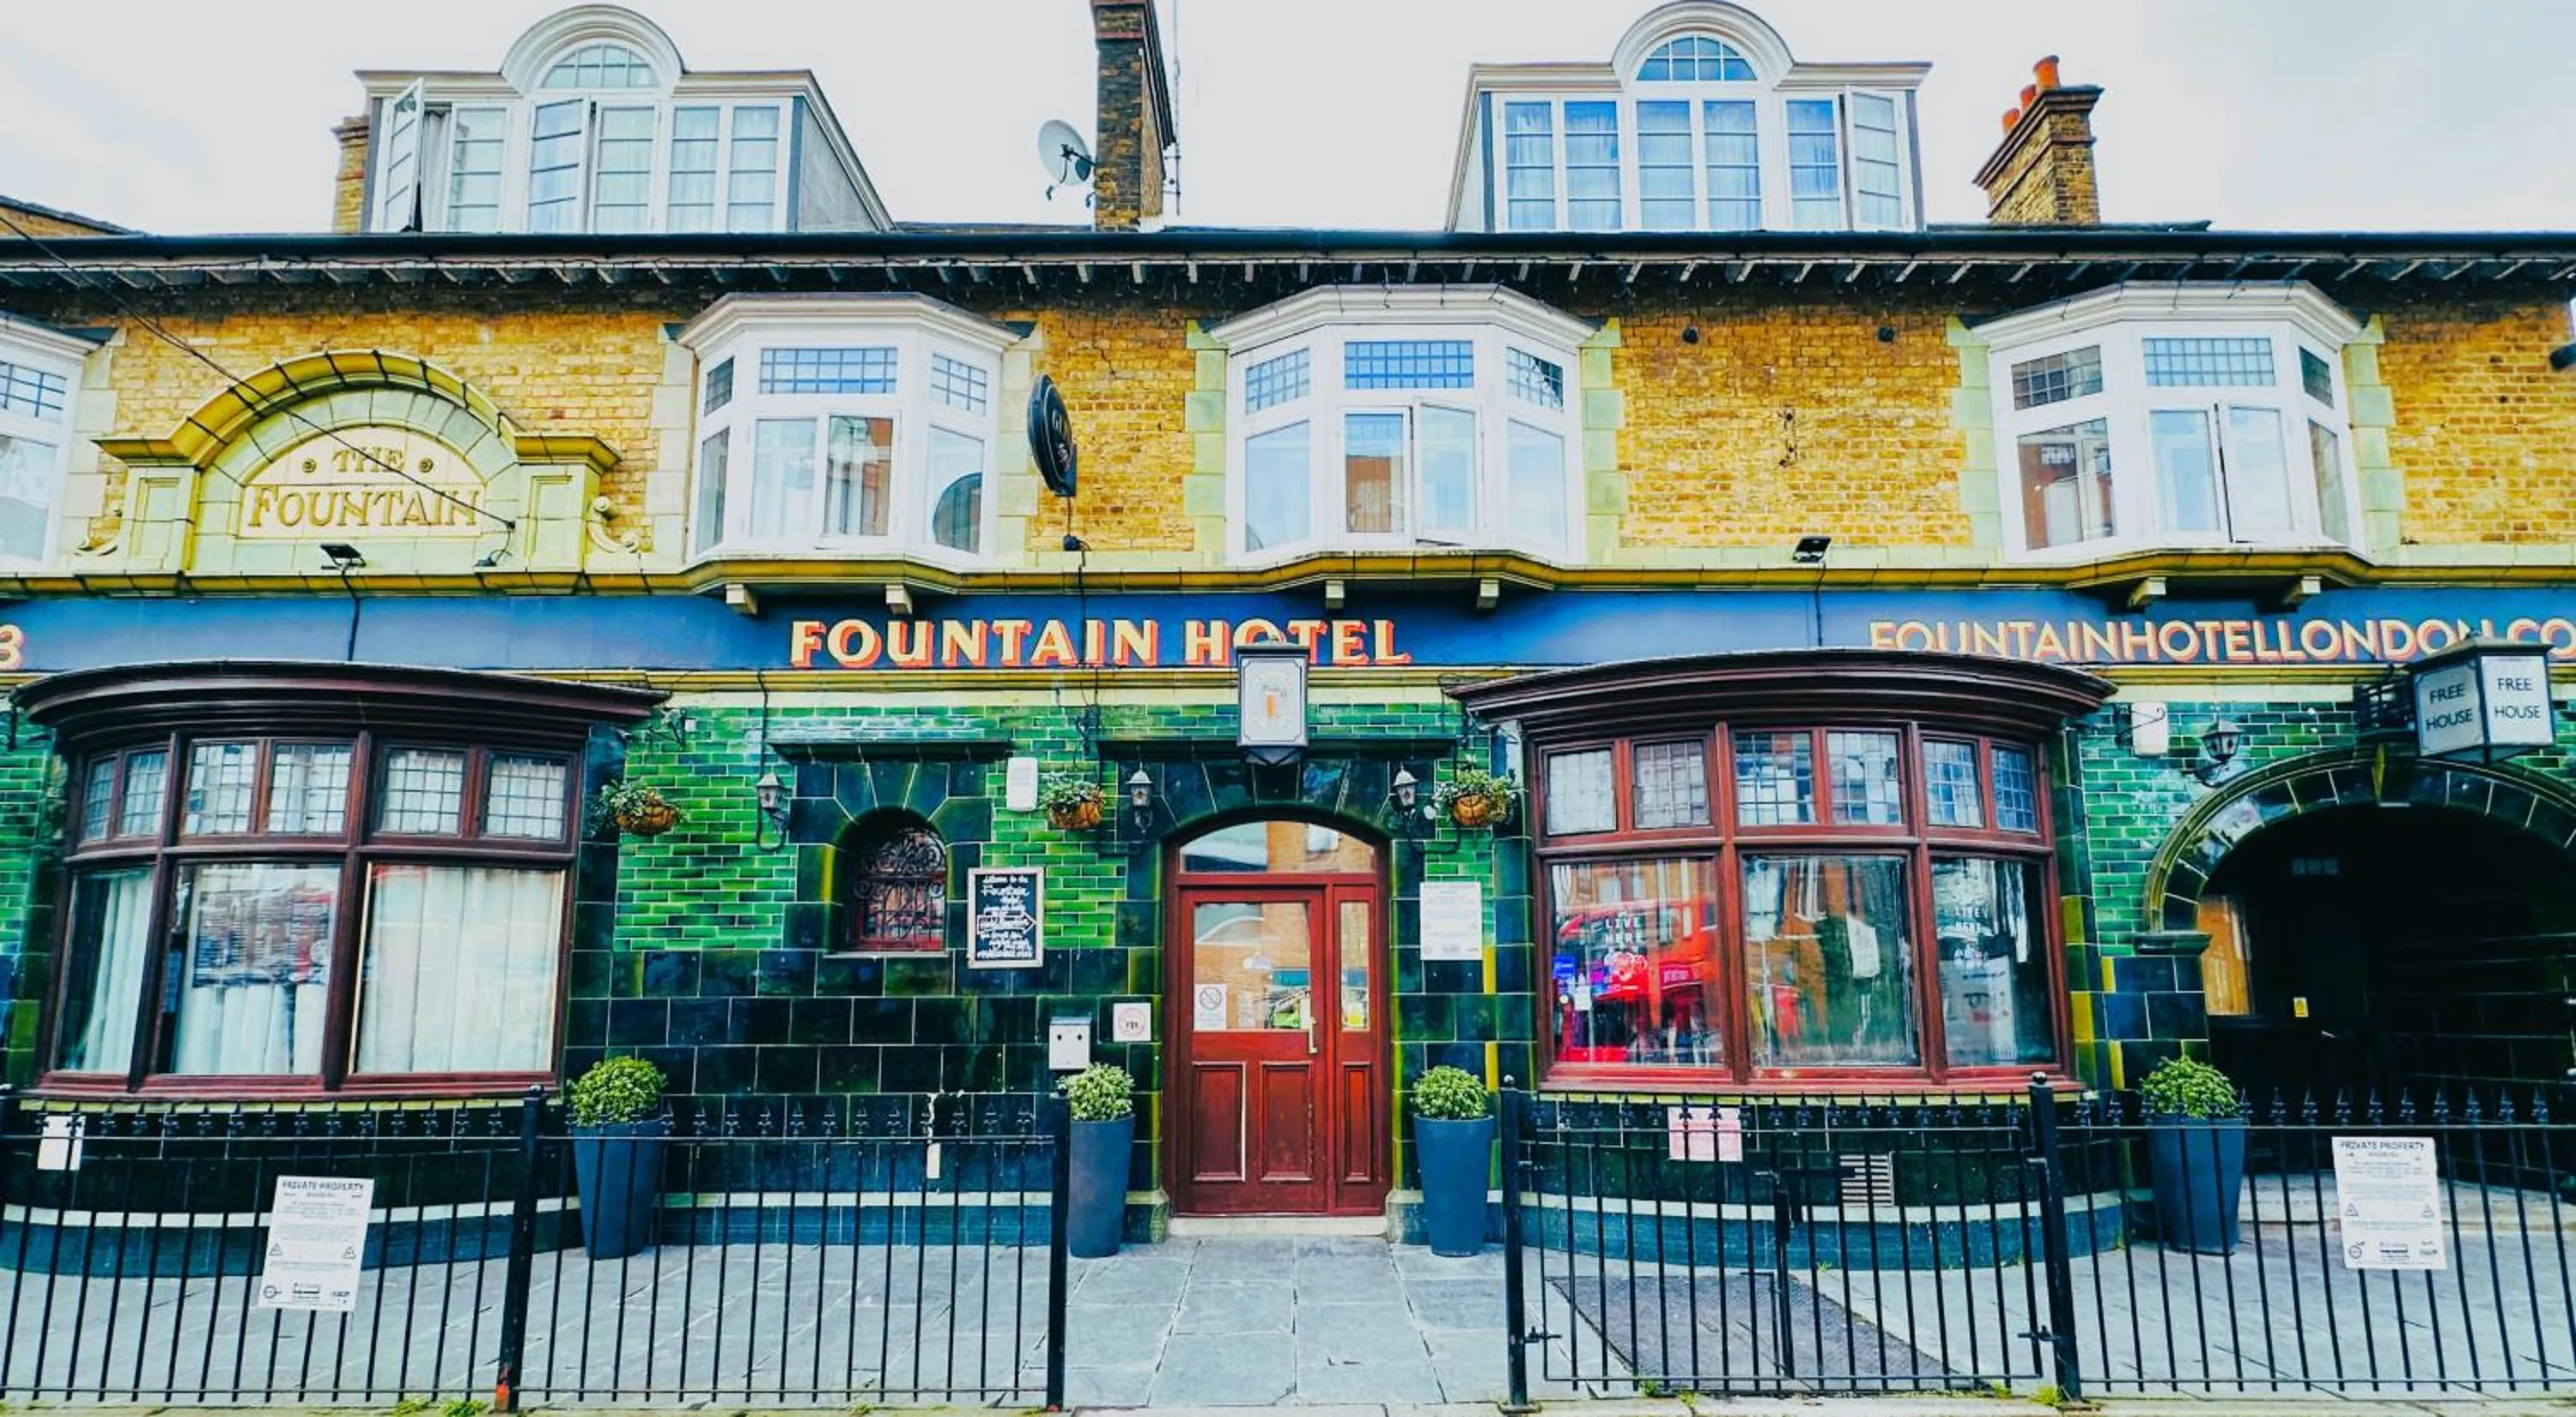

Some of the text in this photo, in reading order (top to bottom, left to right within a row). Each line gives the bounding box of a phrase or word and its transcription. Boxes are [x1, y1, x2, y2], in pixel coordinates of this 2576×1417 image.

[331, 447, 405, 472] THE
[246, 484, 480, 526] FOUNTAIN
[790, 617, 1413, 668] FOUNTAIN HOTEL
[1868, 617, 2576, 661] FOUNTAINHOTELLONDOCO
[2429, 683, 2467, 704] FREE
[2497, 677, 2533, 691] FREE
[2426, 708, 2473, 730] HOUSE
[2494, 705, 2542, 720] HOUSE
